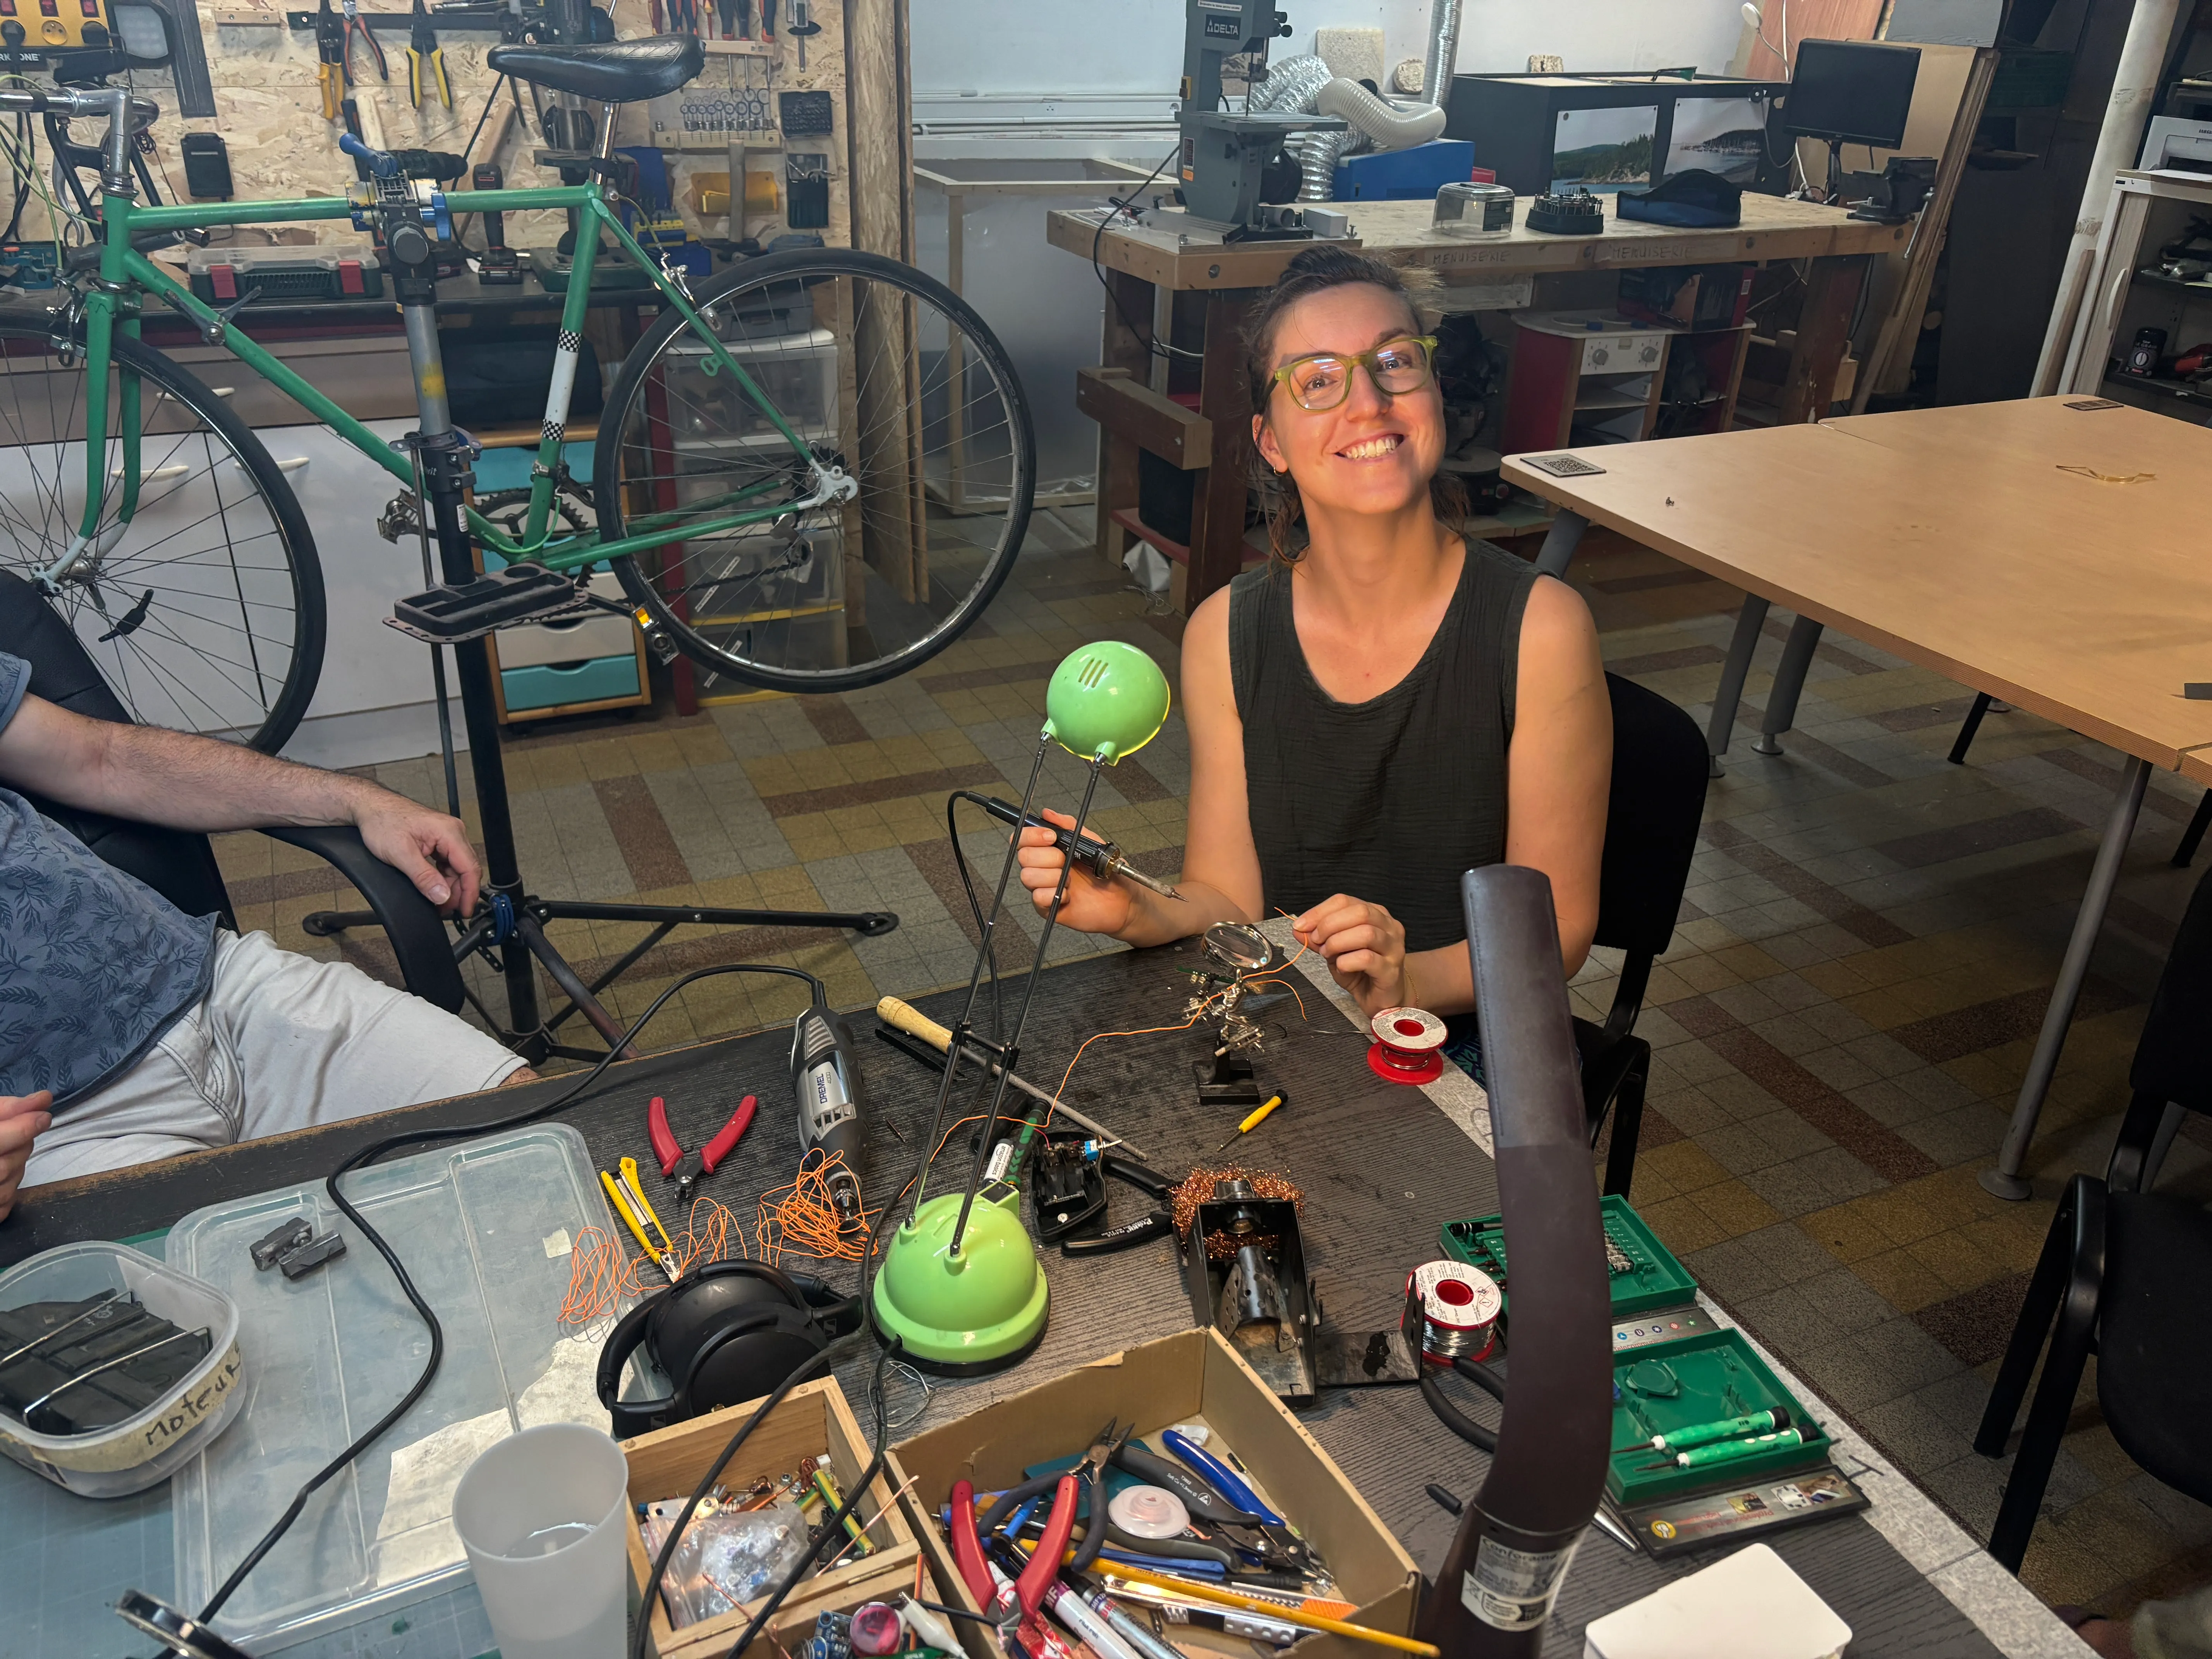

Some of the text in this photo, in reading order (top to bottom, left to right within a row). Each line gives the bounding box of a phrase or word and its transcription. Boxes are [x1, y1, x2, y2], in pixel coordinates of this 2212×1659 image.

[1214, 23, 1238, 35] DELTA
[1612, 245, 1697, 259] MENUISERIE
[816, 1073, 828, 1104] DREMEL
[997, 1145, 1006, 1162] amazon
[992, 1161, 1001, 1175] basics
